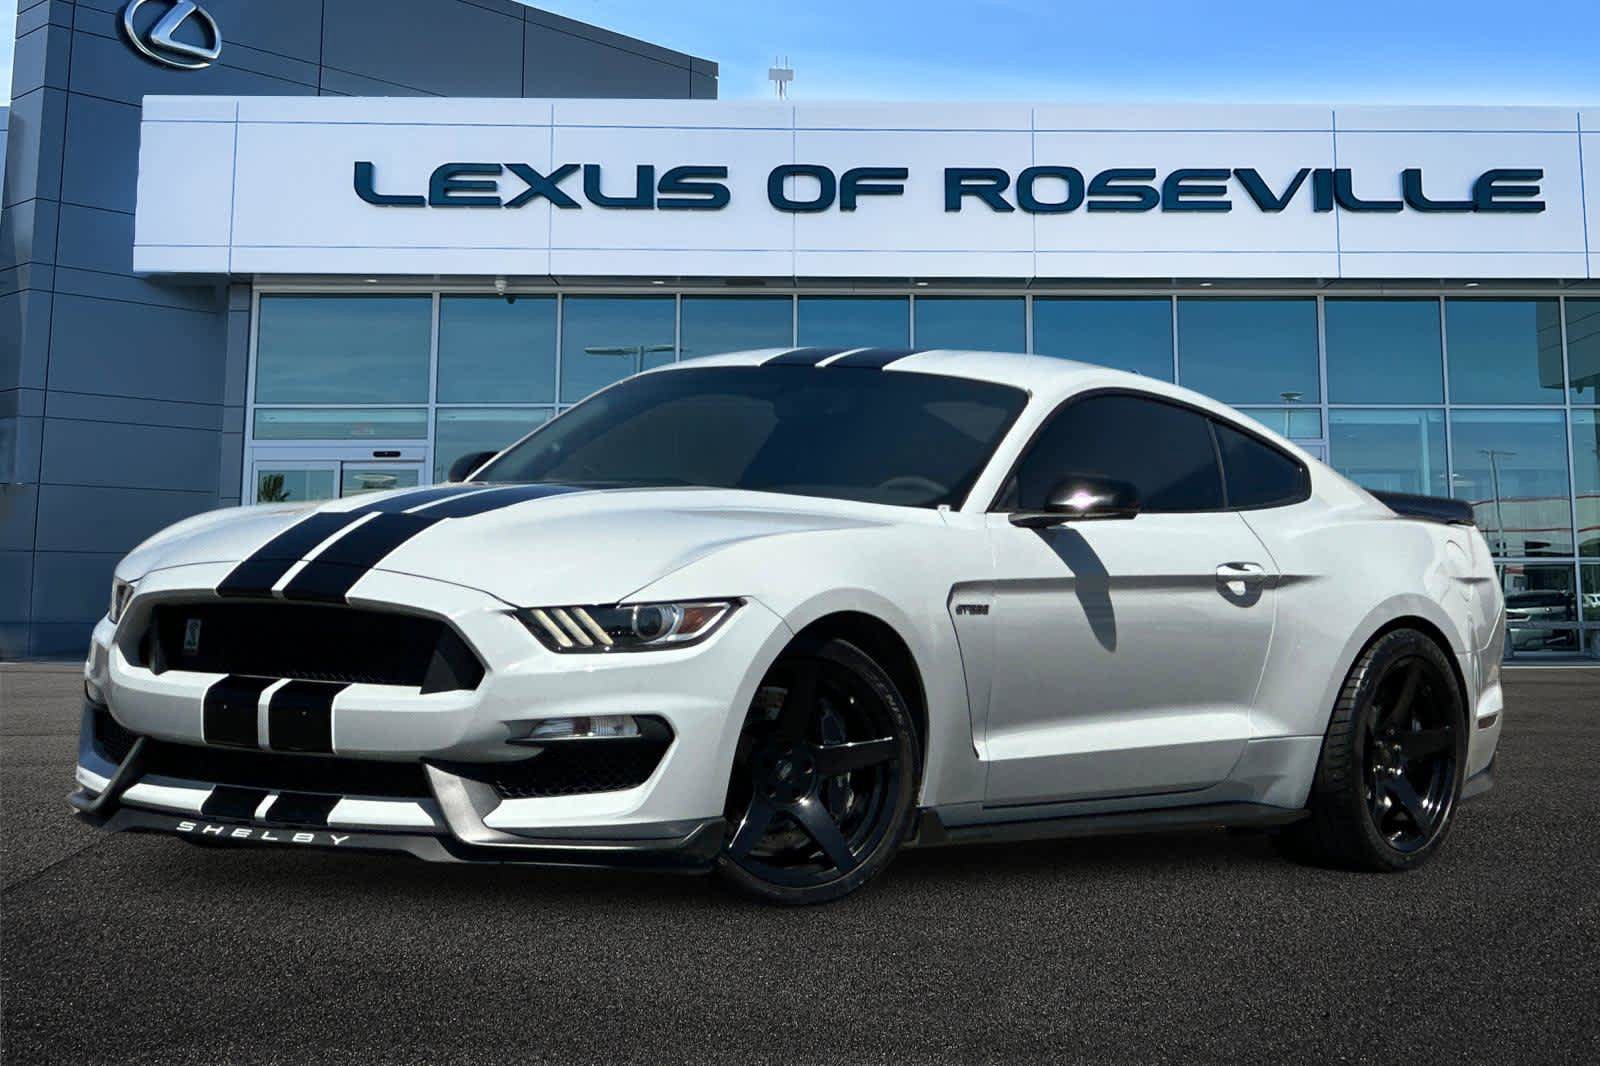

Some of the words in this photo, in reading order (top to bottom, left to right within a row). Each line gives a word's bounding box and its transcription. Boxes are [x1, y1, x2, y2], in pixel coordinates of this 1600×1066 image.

[354, 161, 730, 211] LEXUS
[768, 164, 909, 214] OF
[944, 165, 1546, 215] ROSEVILLE
[176, 820, 350, 846] SHELBY
